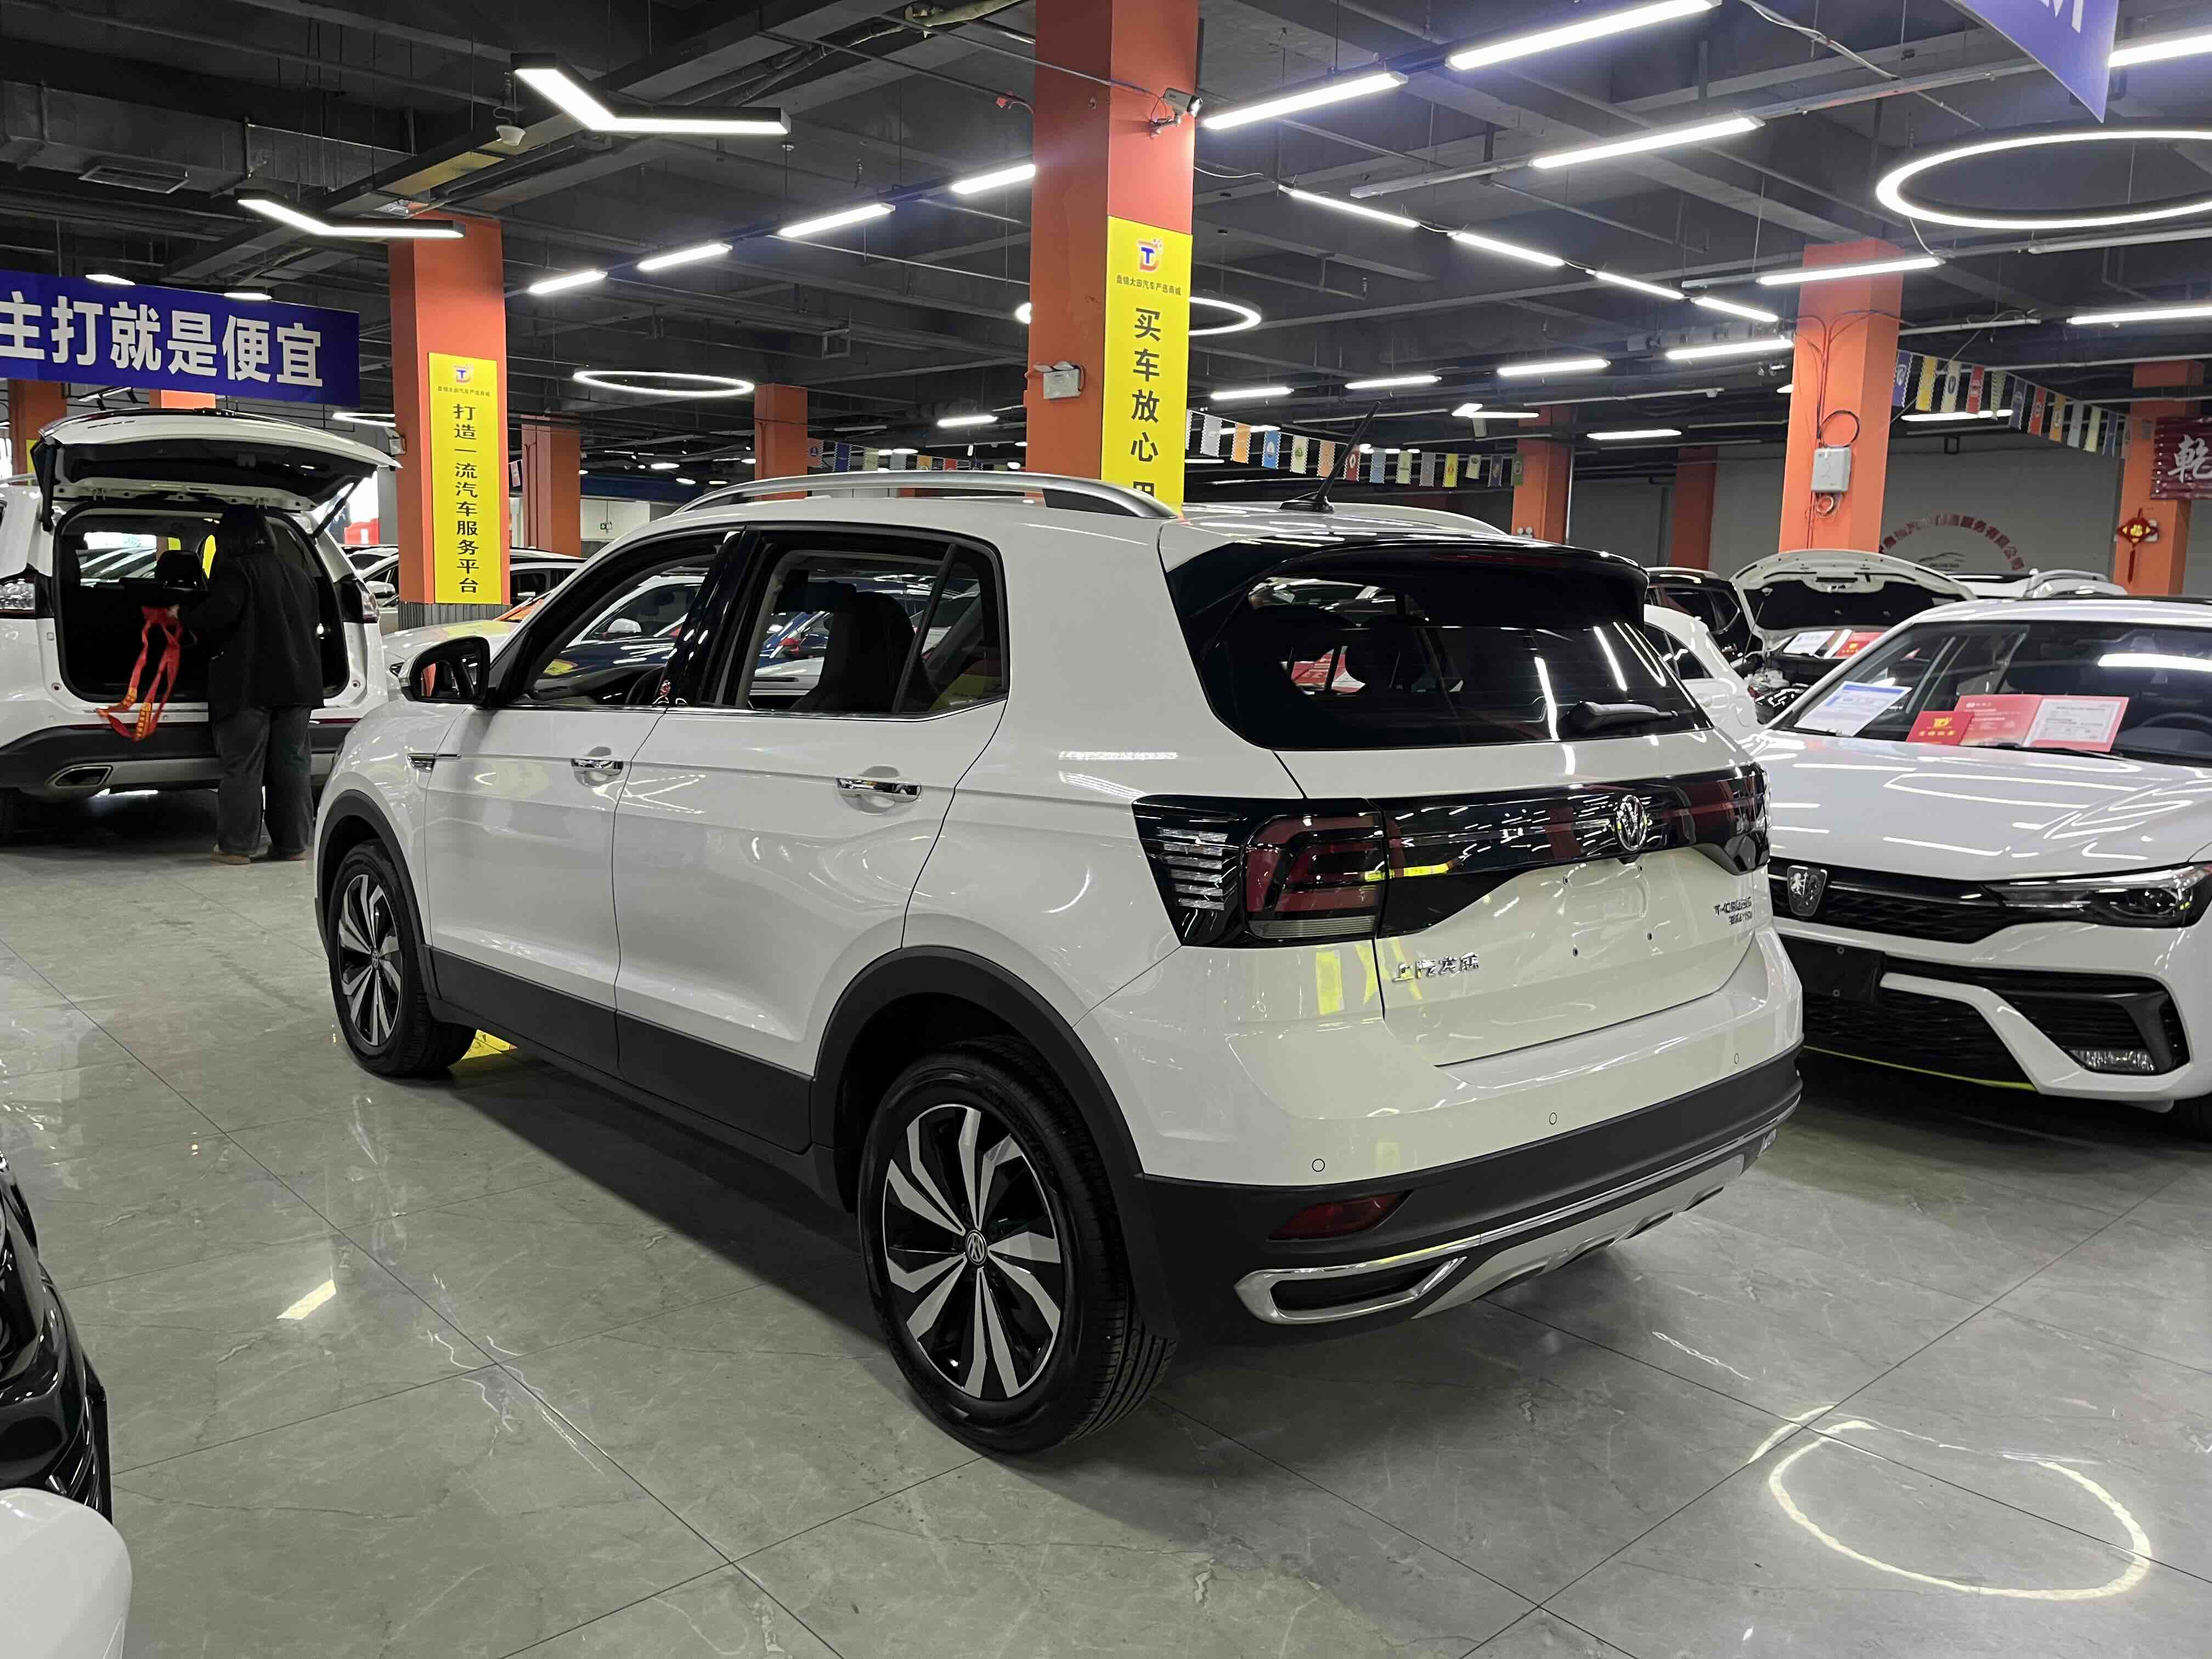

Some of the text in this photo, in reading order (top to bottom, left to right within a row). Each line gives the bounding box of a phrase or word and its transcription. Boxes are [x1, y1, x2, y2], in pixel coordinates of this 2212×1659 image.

[0, 291, 323, 387] 主打就是便宜
[452, 403, 480, 594] 打造一流汽车服务平台
